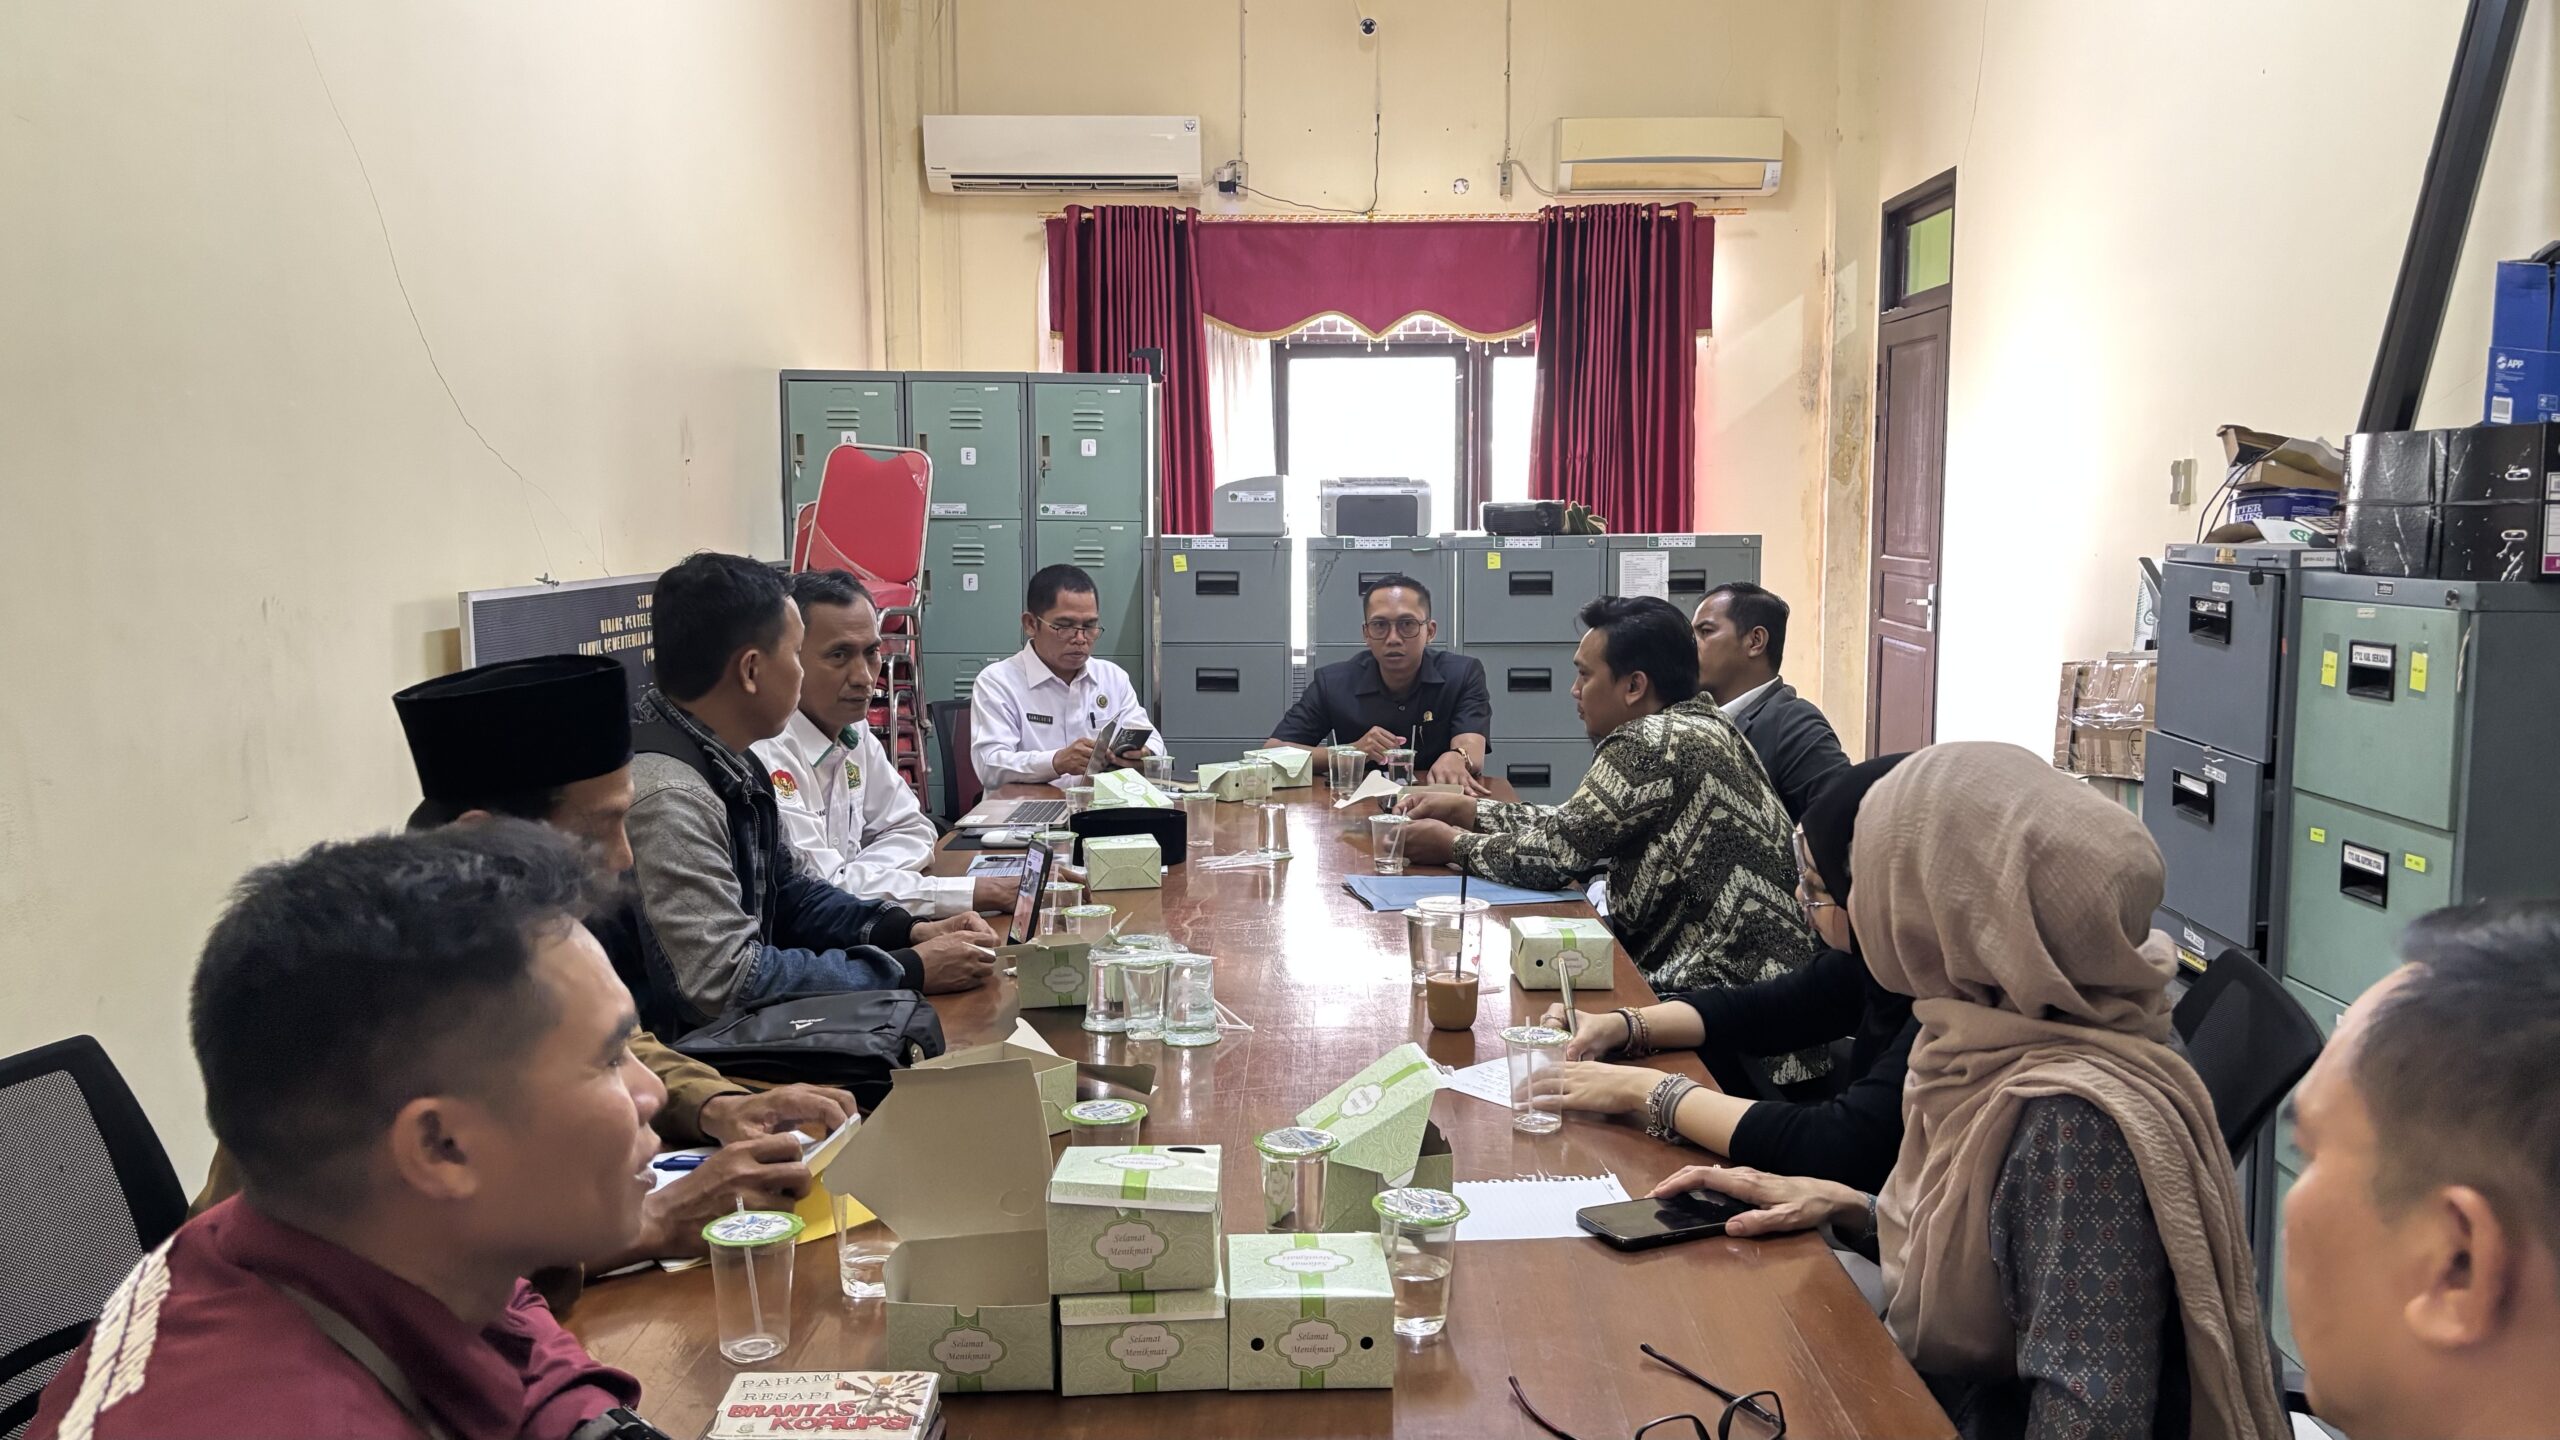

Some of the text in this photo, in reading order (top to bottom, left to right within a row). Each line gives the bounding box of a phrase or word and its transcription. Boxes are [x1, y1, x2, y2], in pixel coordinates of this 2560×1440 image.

[2507, 359, 2525, 369] APP
[966, 451, 971, 461] E
[968, 577, 974, 587] F
[624, 612, 653, 630] PENYELE
[1114, 1233, 1146, 1243] Selamat
[1110, 1246, 1153, 1257] Menikmati
[1129, 1334, 1161, 1344] Selamat
[1296, 1332, 1329, 1341] Selamat
[952, 1339, 984, 1348] Selamat
[1126, 1347, 1168, 1357] Menikmati
[1291, 1344, 1336, 1355] Menikmati
[948, 1352, 991, 1361] Menikmati
[740, 1372, 843, 1389] PAHAMI
[743, 1391, 831, 1401] RESAPI
[727, 1402, 858, 1418] BRANTAS
[768, 1415, 914, 1432] KORUPSI
